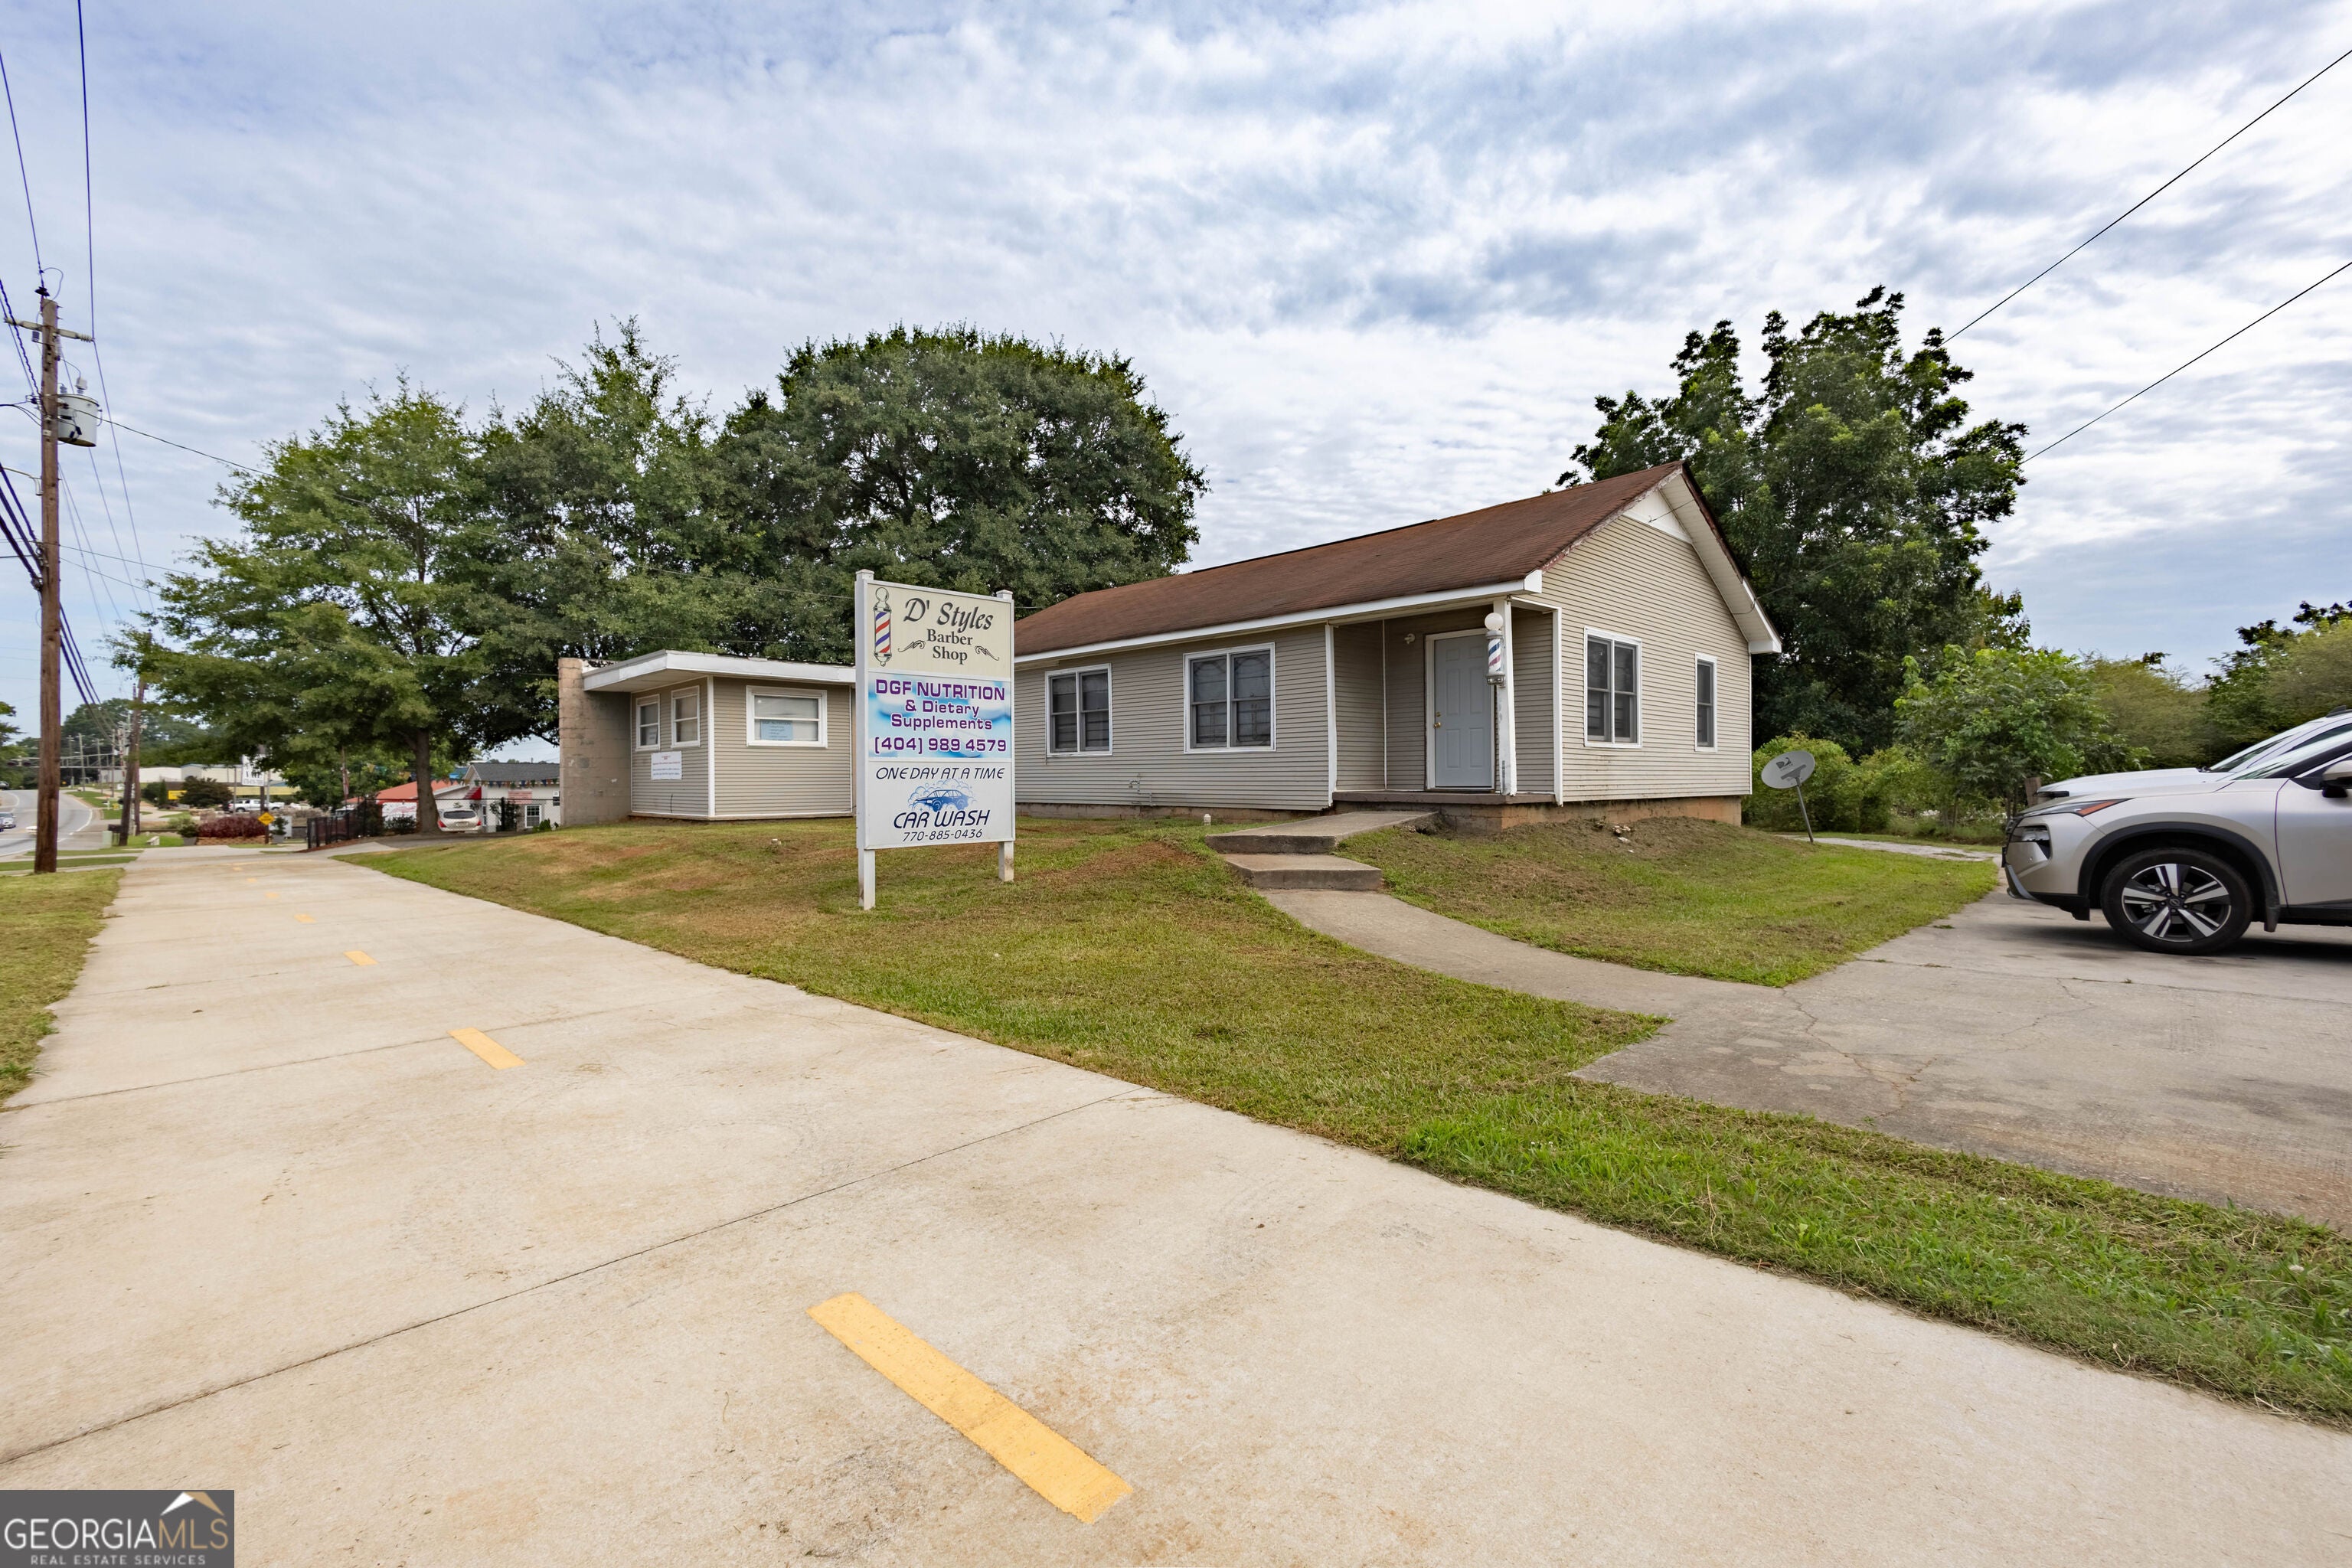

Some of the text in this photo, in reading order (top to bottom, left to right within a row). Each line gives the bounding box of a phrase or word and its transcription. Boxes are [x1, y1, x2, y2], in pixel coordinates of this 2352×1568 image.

[936, 602, 994, 633] Styles
[926, 629, 973, 645] Barber
[933, 645, 968, 665] Shop
[876, 679, 1005, 701] DGF NUTRITION
[905, 699, 979, 717] & Dietary
[891, 714, 992, 731] Supplements
[928, 738, 960, 752] 989
[965, 739, 1007, 752] 4579
[940, 767, 959, 779] AT
[960, 767, 970, 779] A
[974, 767, 1005, 779] TIME
[893, 809, 991, 828] CAR WASH
[903, 828, 983, 842] 770-885-0436
